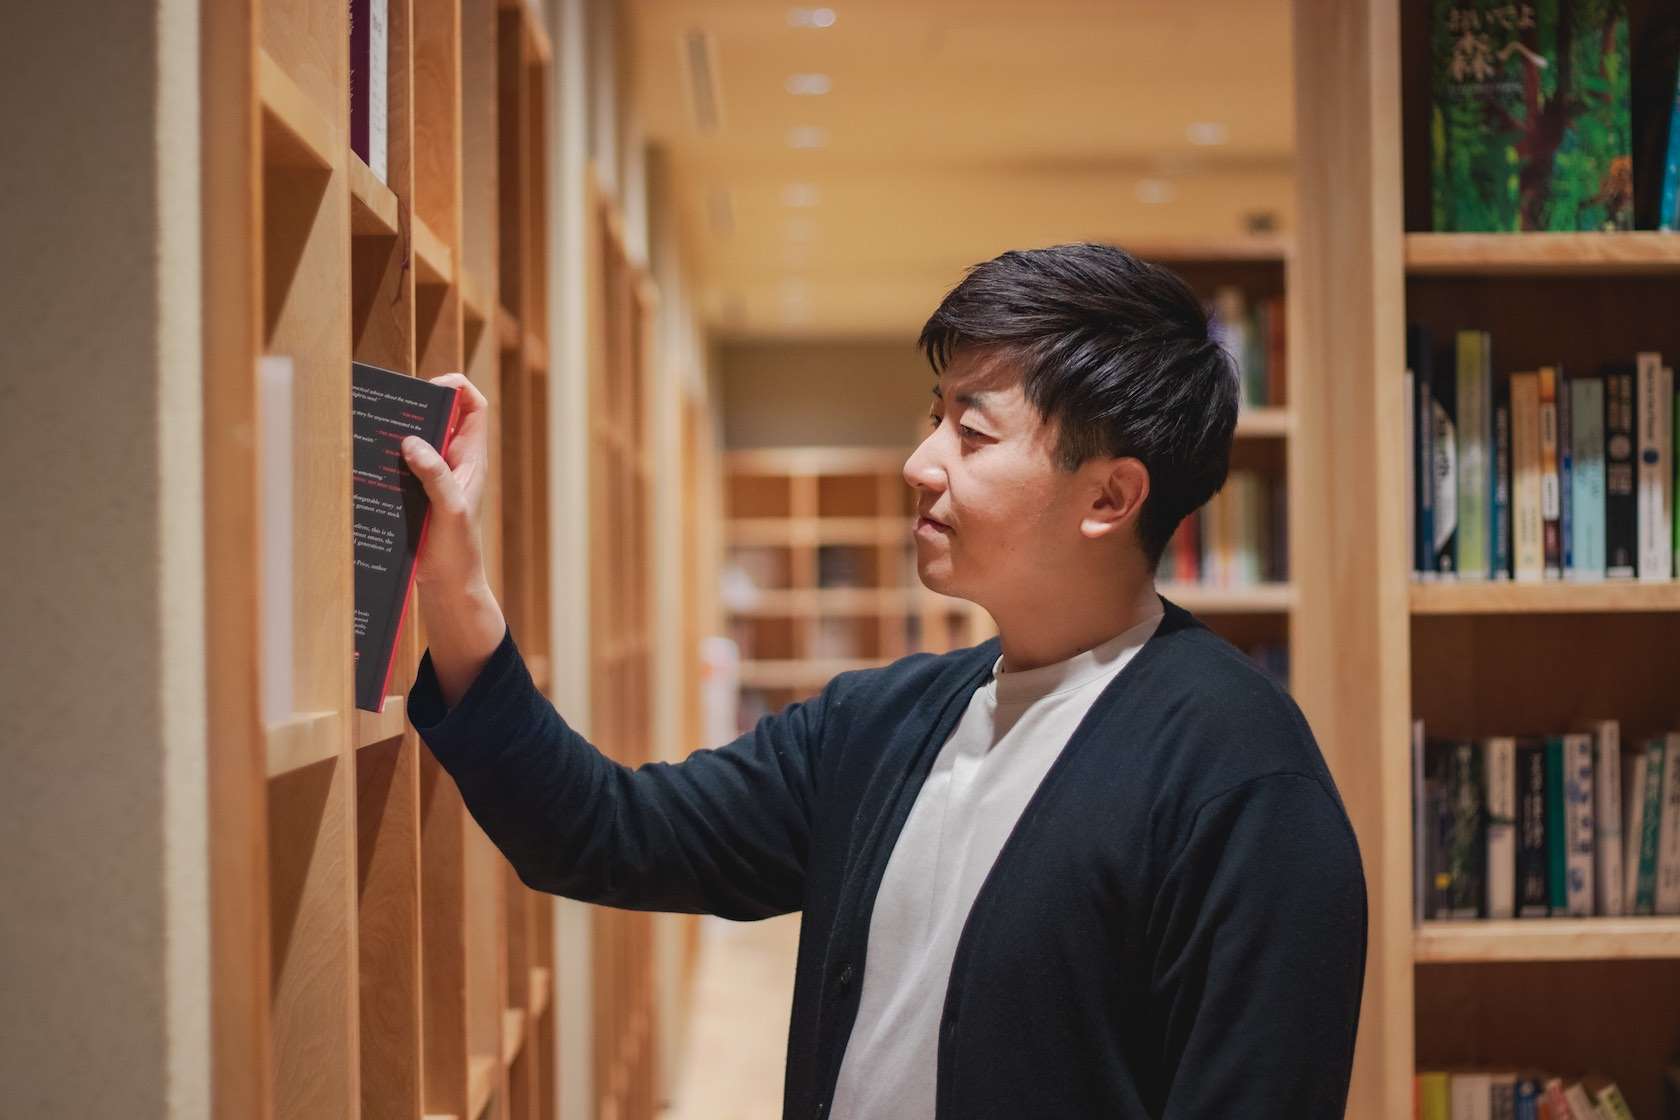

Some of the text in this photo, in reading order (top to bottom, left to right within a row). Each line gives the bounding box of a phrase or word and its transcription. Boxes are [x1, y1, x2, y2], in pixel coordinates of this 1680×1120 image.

[1447, 31, 1550, 82] 森へ
[369, 389, 384, 397] advice
[384, 393, 397, 401] about
[390, 419, 411, 428] interested
[356, 503, 375, 512] greatest
[381, 502, 394, 510] story
[357, 541, 385, 551] generations
[356, 559, 371, 569] Price,
[370, 564, 388, 572] author
